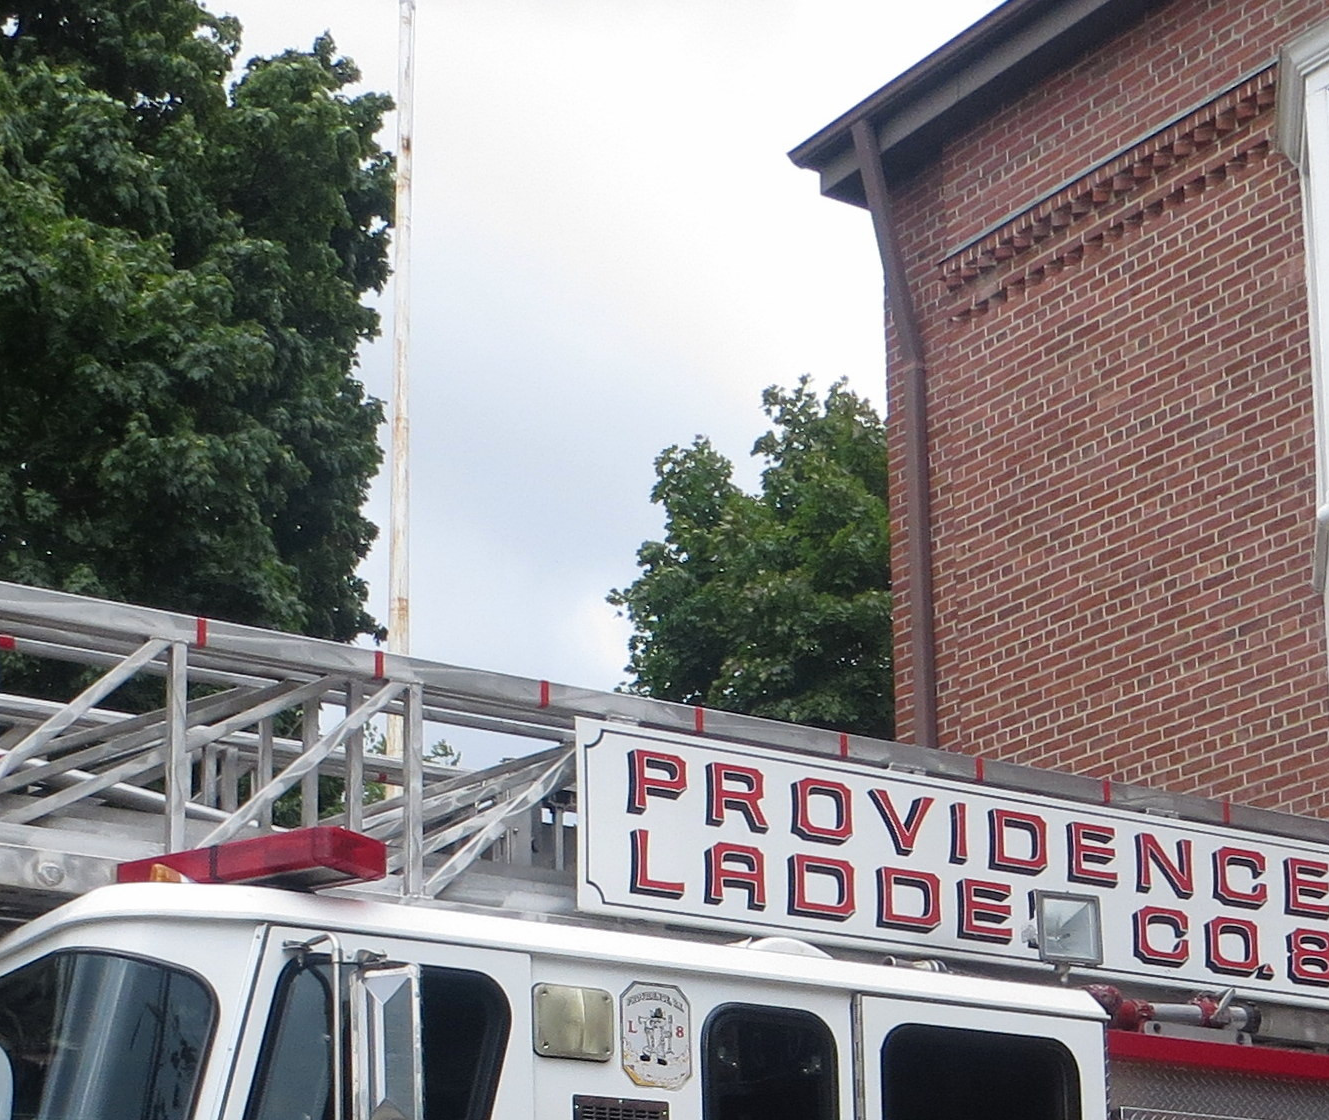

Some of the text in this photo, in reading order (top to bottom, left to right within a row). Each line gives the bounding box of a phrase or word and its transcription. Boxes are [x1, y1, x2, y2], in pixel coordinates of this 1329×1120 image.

[629, 828, 1041, 950] LADDE
[628, 1020, 684, 1038] L 8
